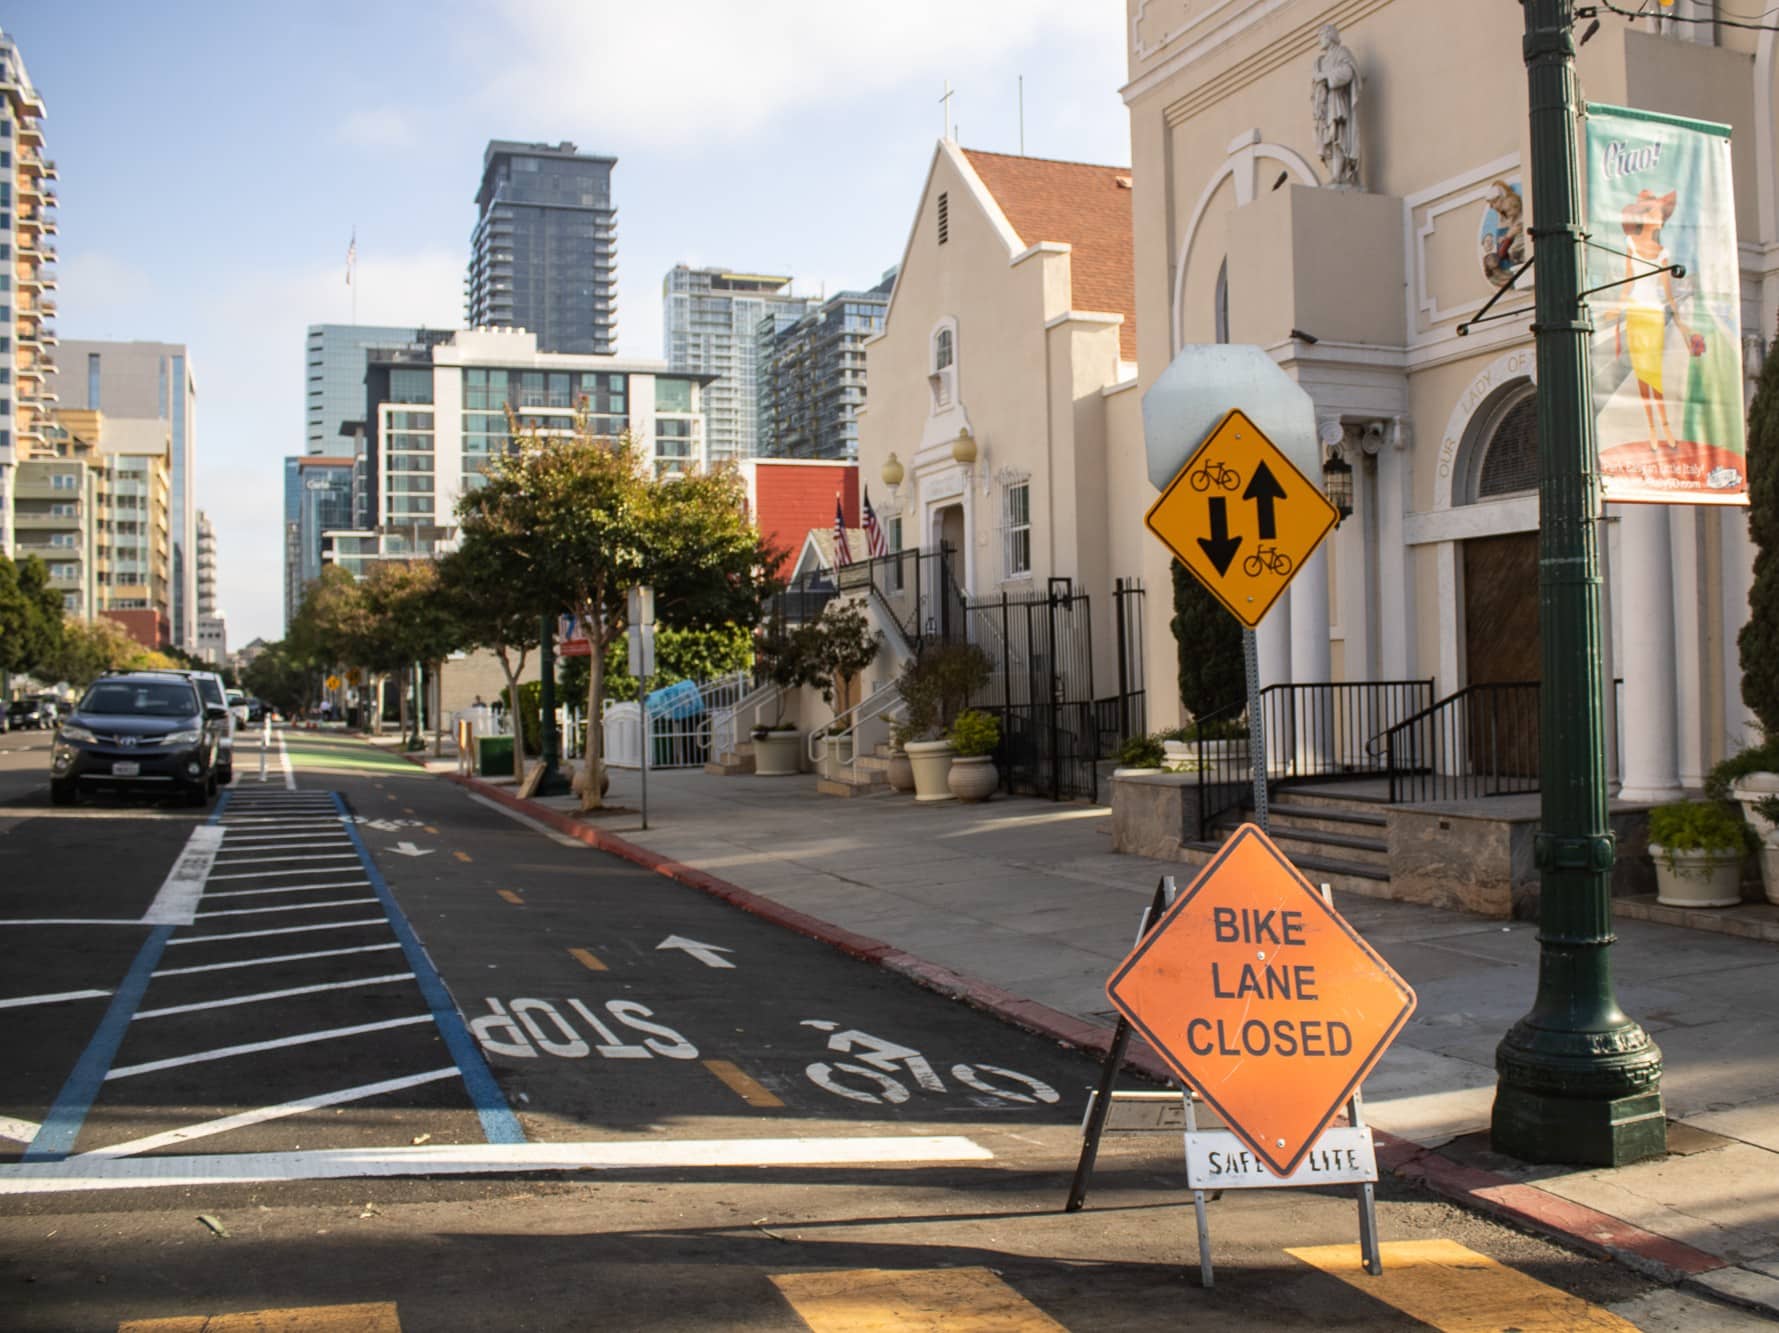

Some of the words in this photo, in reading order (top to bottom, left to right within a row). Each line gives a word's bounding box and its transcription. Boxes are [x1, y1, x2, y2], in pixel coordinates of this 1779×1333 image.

[1602, 140, 1662, 181] Ciao!
[1439, 438, 1457, 478] OUR
[1461, 369, 1492, 414] LADY
[1508, 353, 1527, 373] OF
[1213, 907, 1306, 946] BIKE
[1212, 963, 1319, 1001] LANE
[469, 997, 700, 1060] STOP
[1187, 1018, 1353, 1057] CLOSED
[1310, 1149, 1360, 1172] LITE
